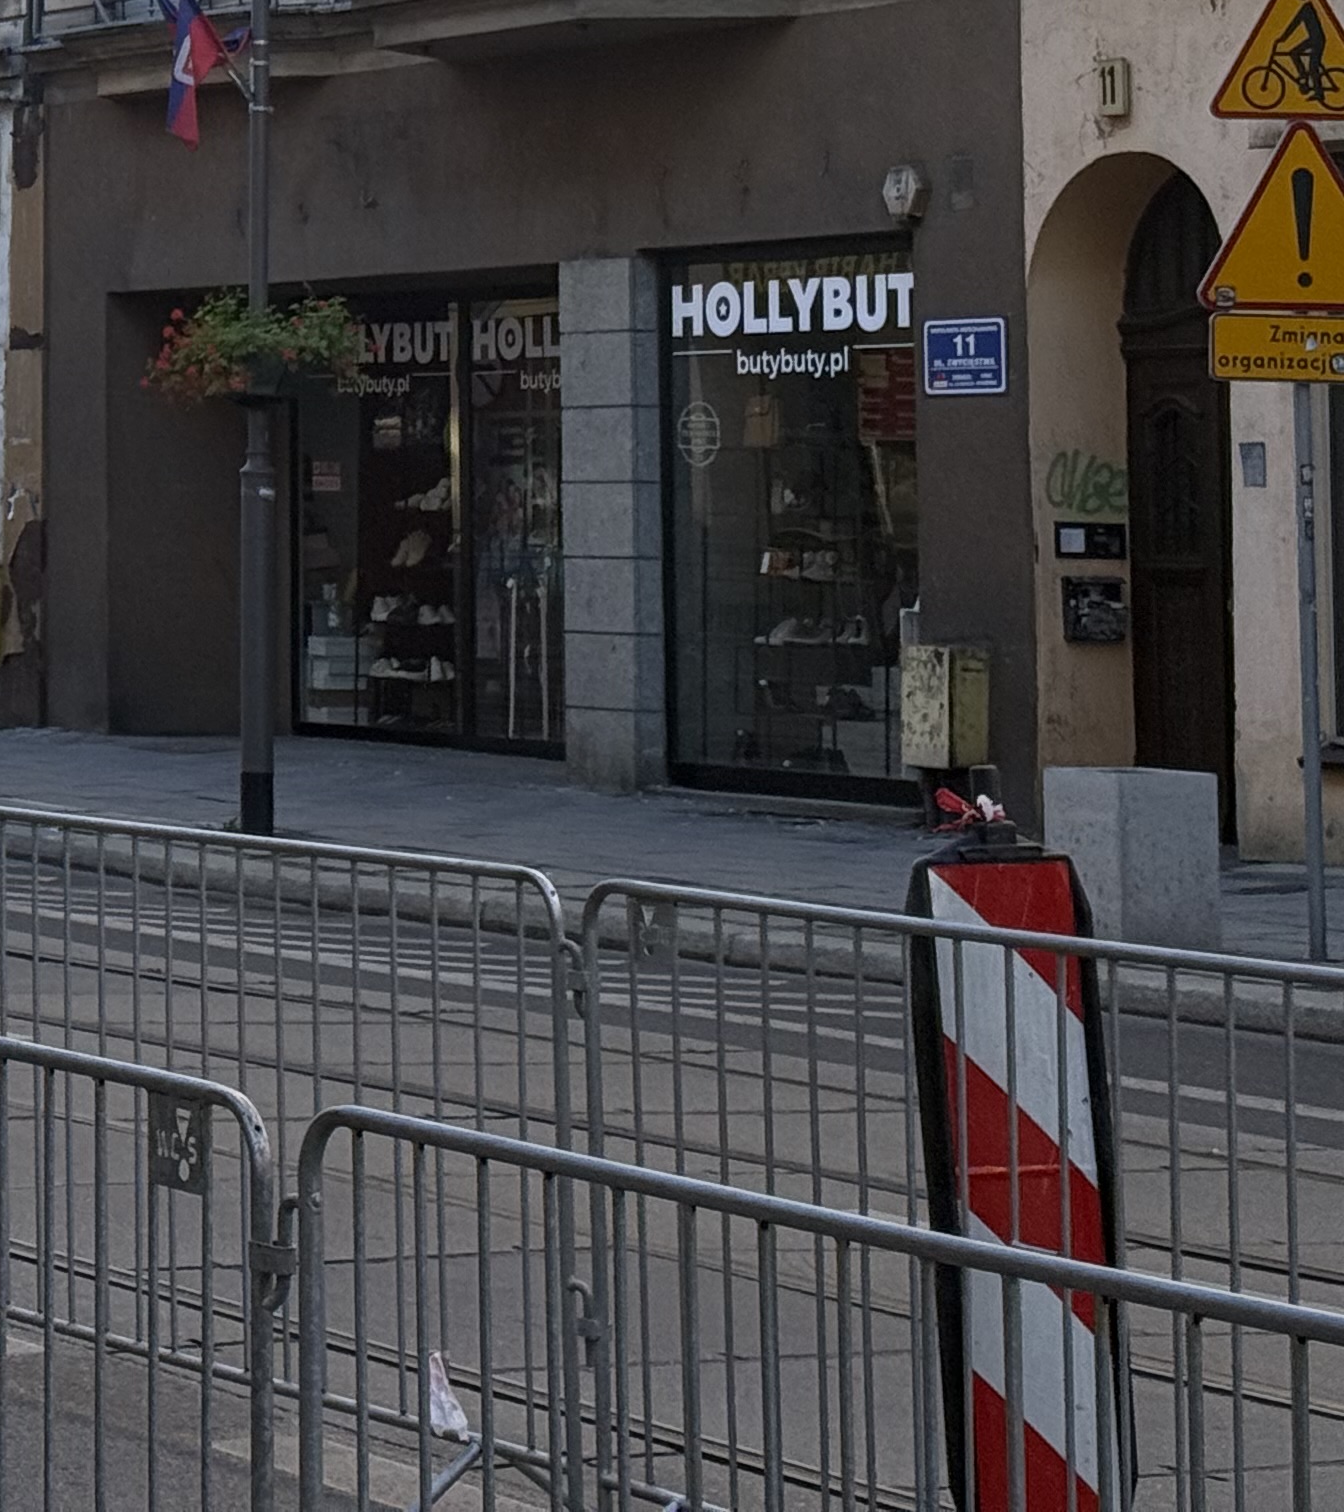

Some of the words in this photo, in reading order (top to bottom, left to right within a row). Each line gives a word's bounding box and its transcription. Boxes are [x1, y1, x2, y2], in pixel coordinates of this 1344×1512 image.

[1098, 65, 1116, 105] 11
[672, 272, 914, 338] HOLLYBUT
[736, 345, 849, 380] butybuty.pl
[953, 334, 975, 356] 11
[1217, 351, 1332, 375] organizacj
